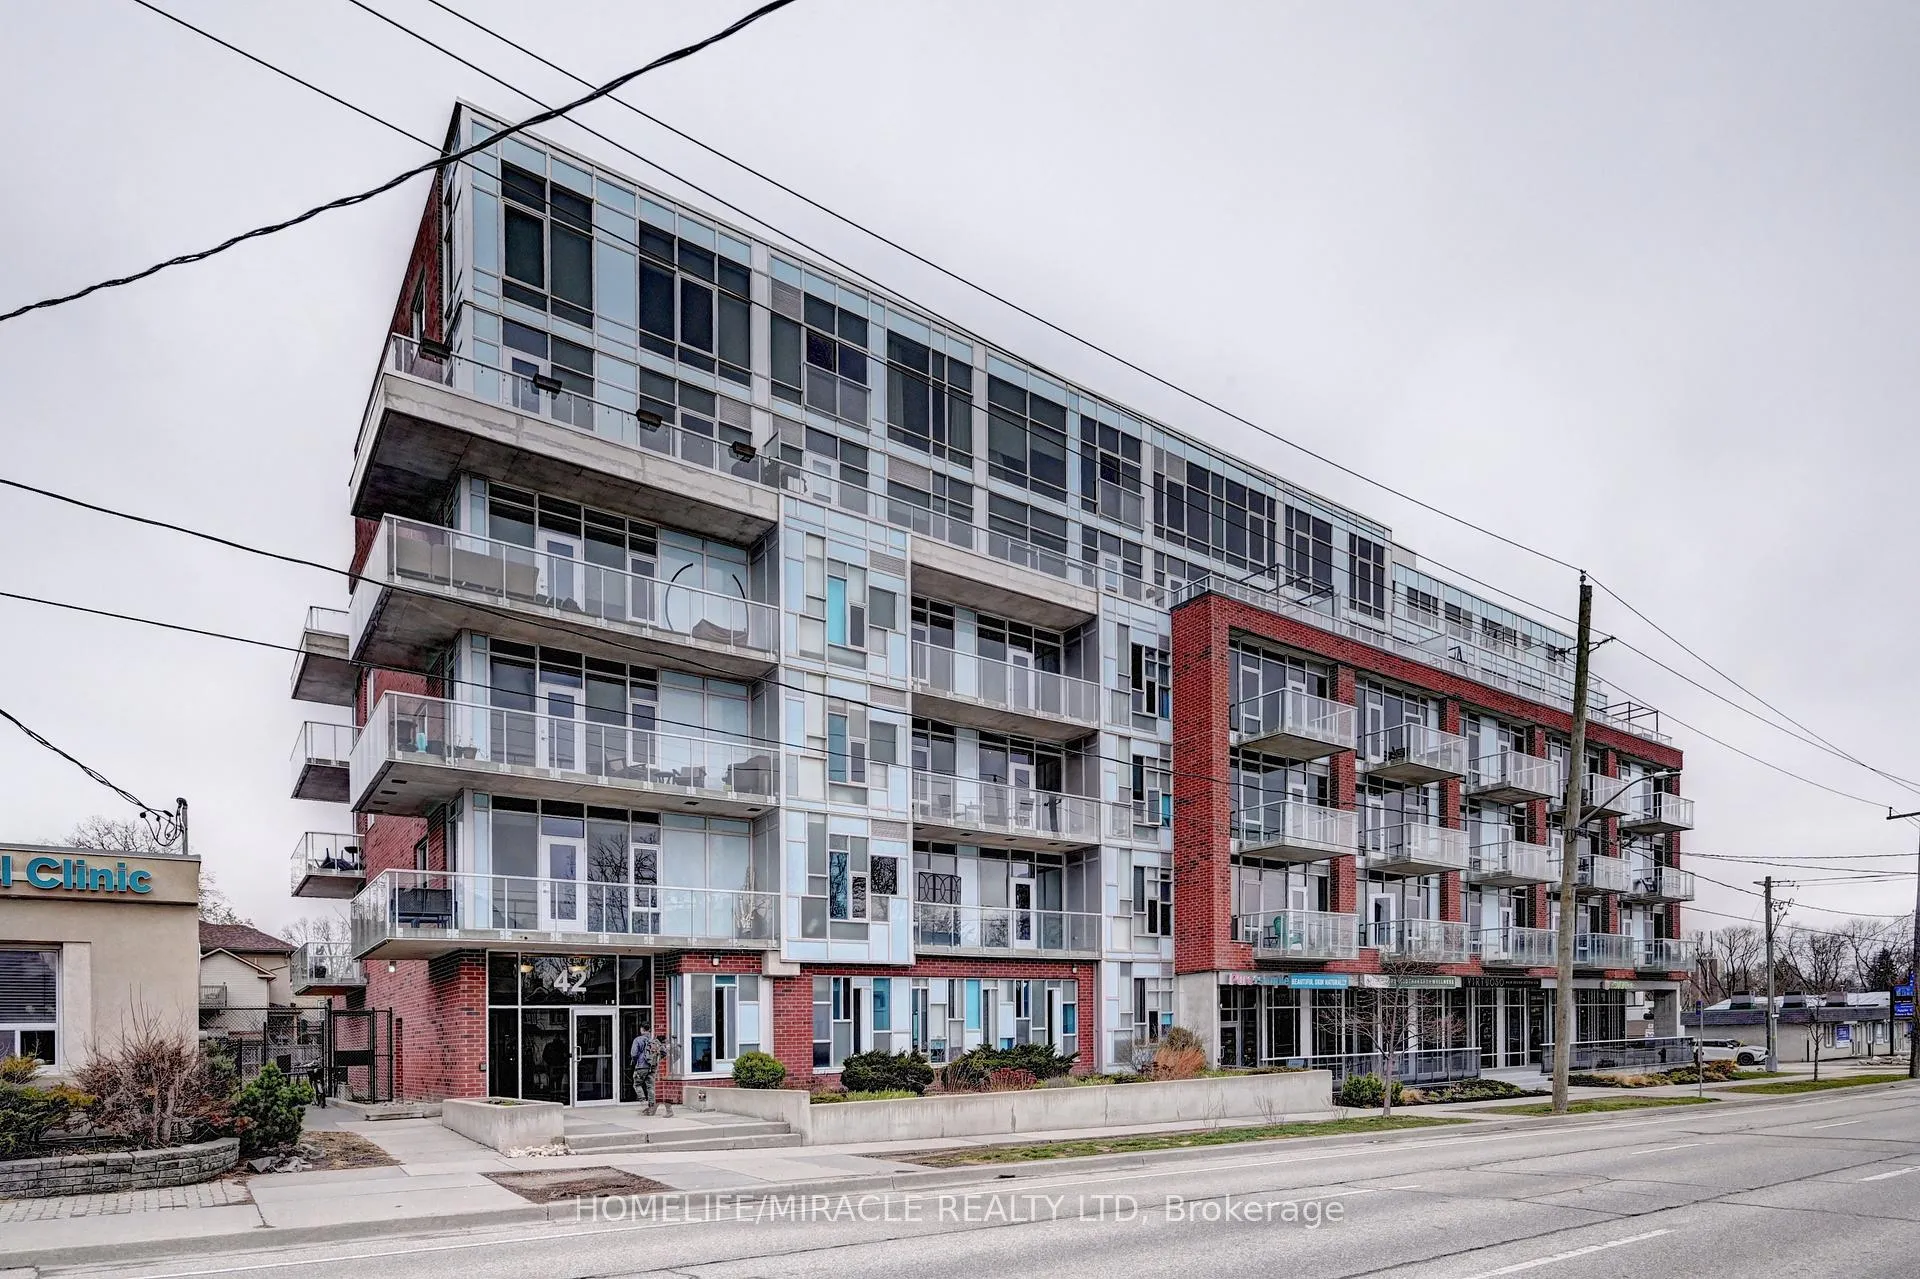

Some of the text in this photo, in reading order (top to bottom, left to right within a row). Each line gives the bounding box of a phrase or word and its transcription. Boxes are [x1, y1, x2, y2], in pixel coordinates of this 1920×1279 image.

[26, 857, 153, 894] Clinic
[554, 969, 587, 992] 42
[1467, 977, 1504, 987] VIRTUOSO
